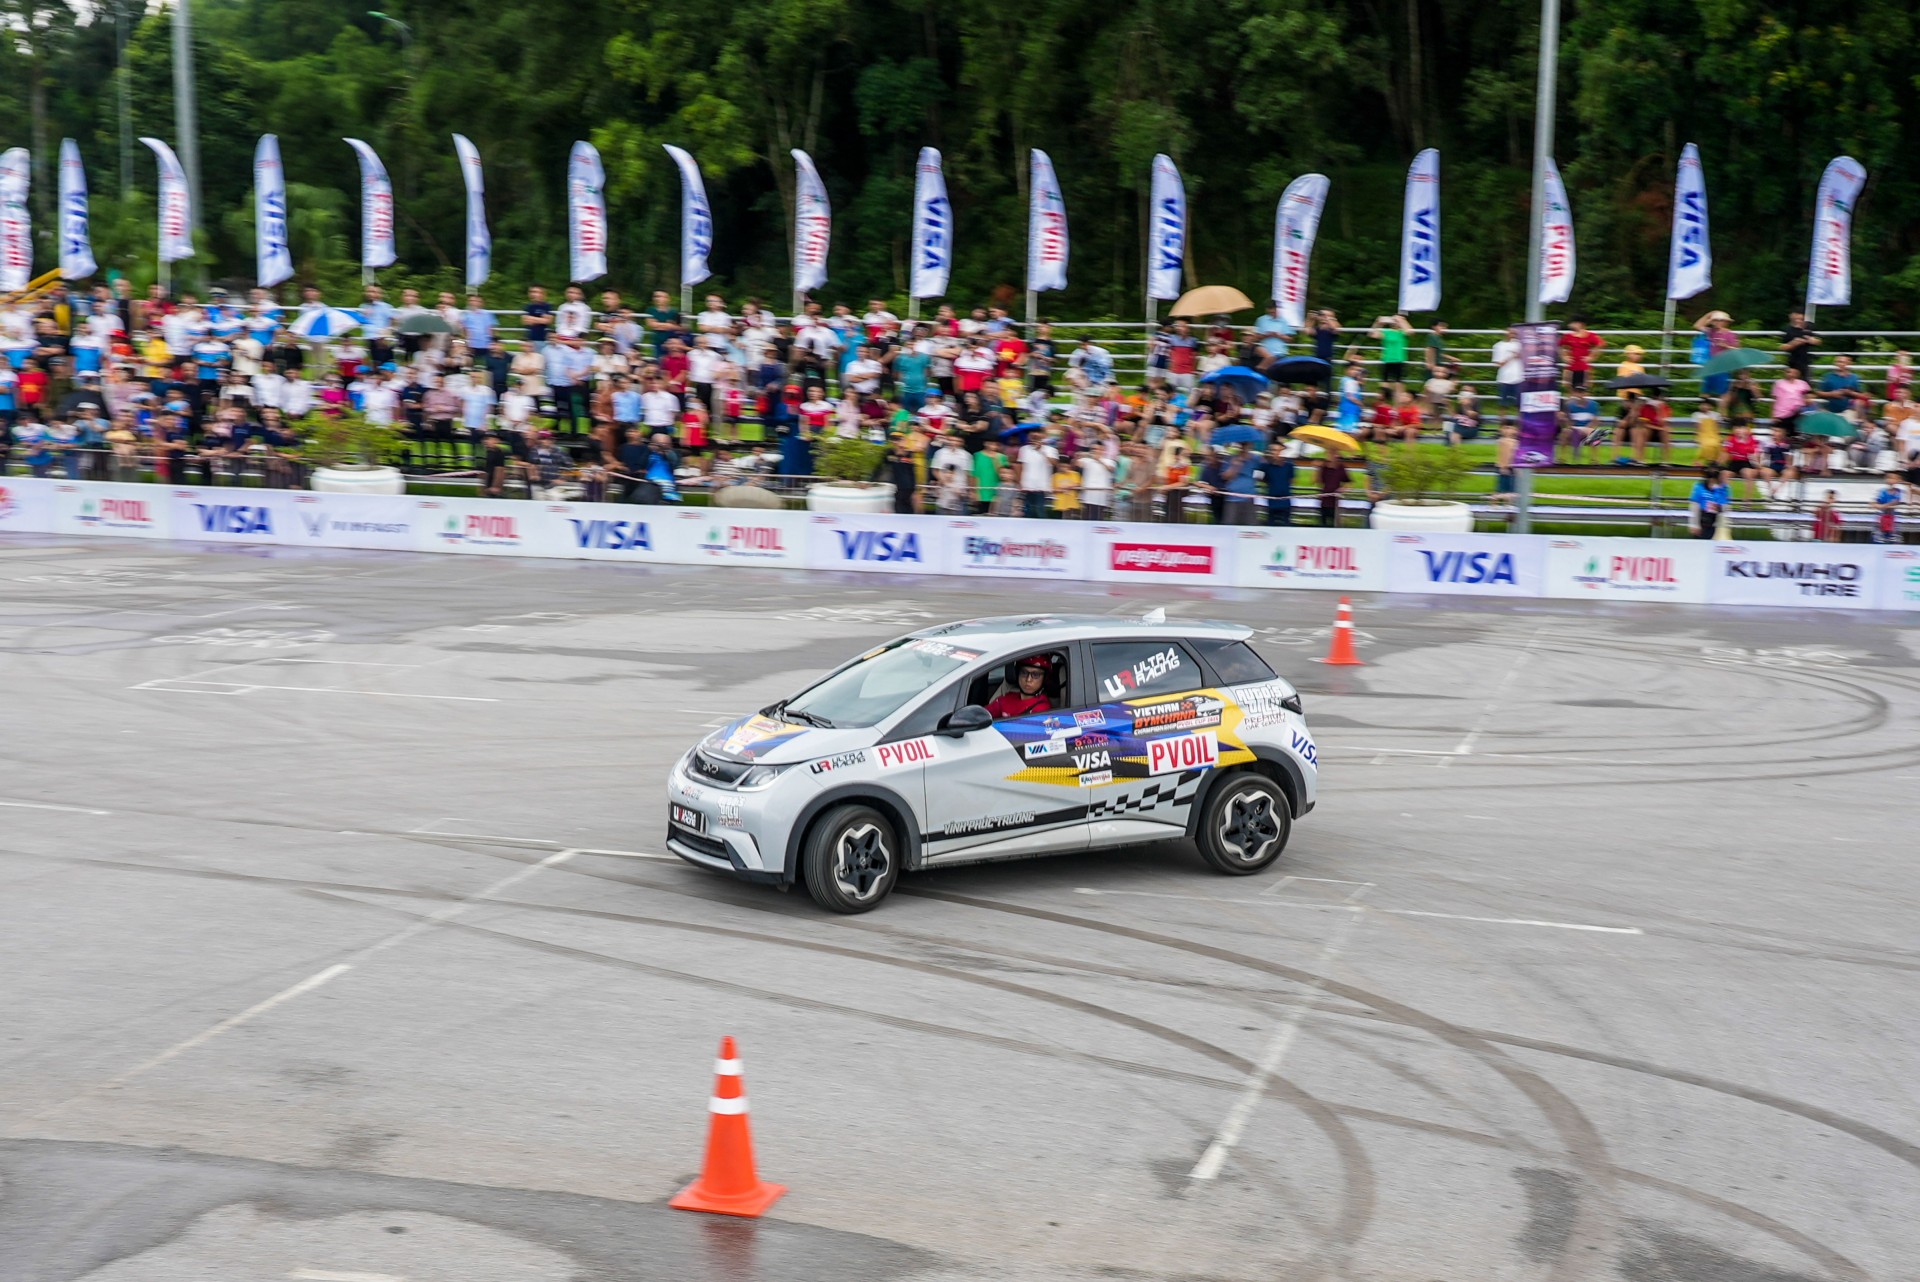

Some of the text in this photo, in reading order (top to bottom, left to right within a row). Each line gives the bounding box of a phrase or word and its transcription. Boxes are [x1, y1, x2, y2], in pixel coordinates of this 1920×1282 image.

[923, 197, 950, 270] VISA
[1157, 198, 1183, 271] VISA
[1679, 191, 1706, 269] VISA
[1409, 207, 1437, 286] VISA
[191, 503, 274, 535] VISA
[566, 518, 655, 552] VISA
[831, 530, 924, 563] VISA
[1414, 550, 1518, 585] VISA
[1725, 560, 1863, 583] KUMHO
[1797, 582, 1861, 599] TIRE
[1133, 647, 1179, 674] ULTRA
[1135, 657, 1180, 687] RACING
[1133, 702, 1179, 718] VIETNAM
[1134, 723, 1177, 736] CHAMPIONSHIP
[878, 739, 934, 767] PVOIL
[1071, 750, 1111, 770] VISA
[1152, 736, 1214, 771] PVOIL
